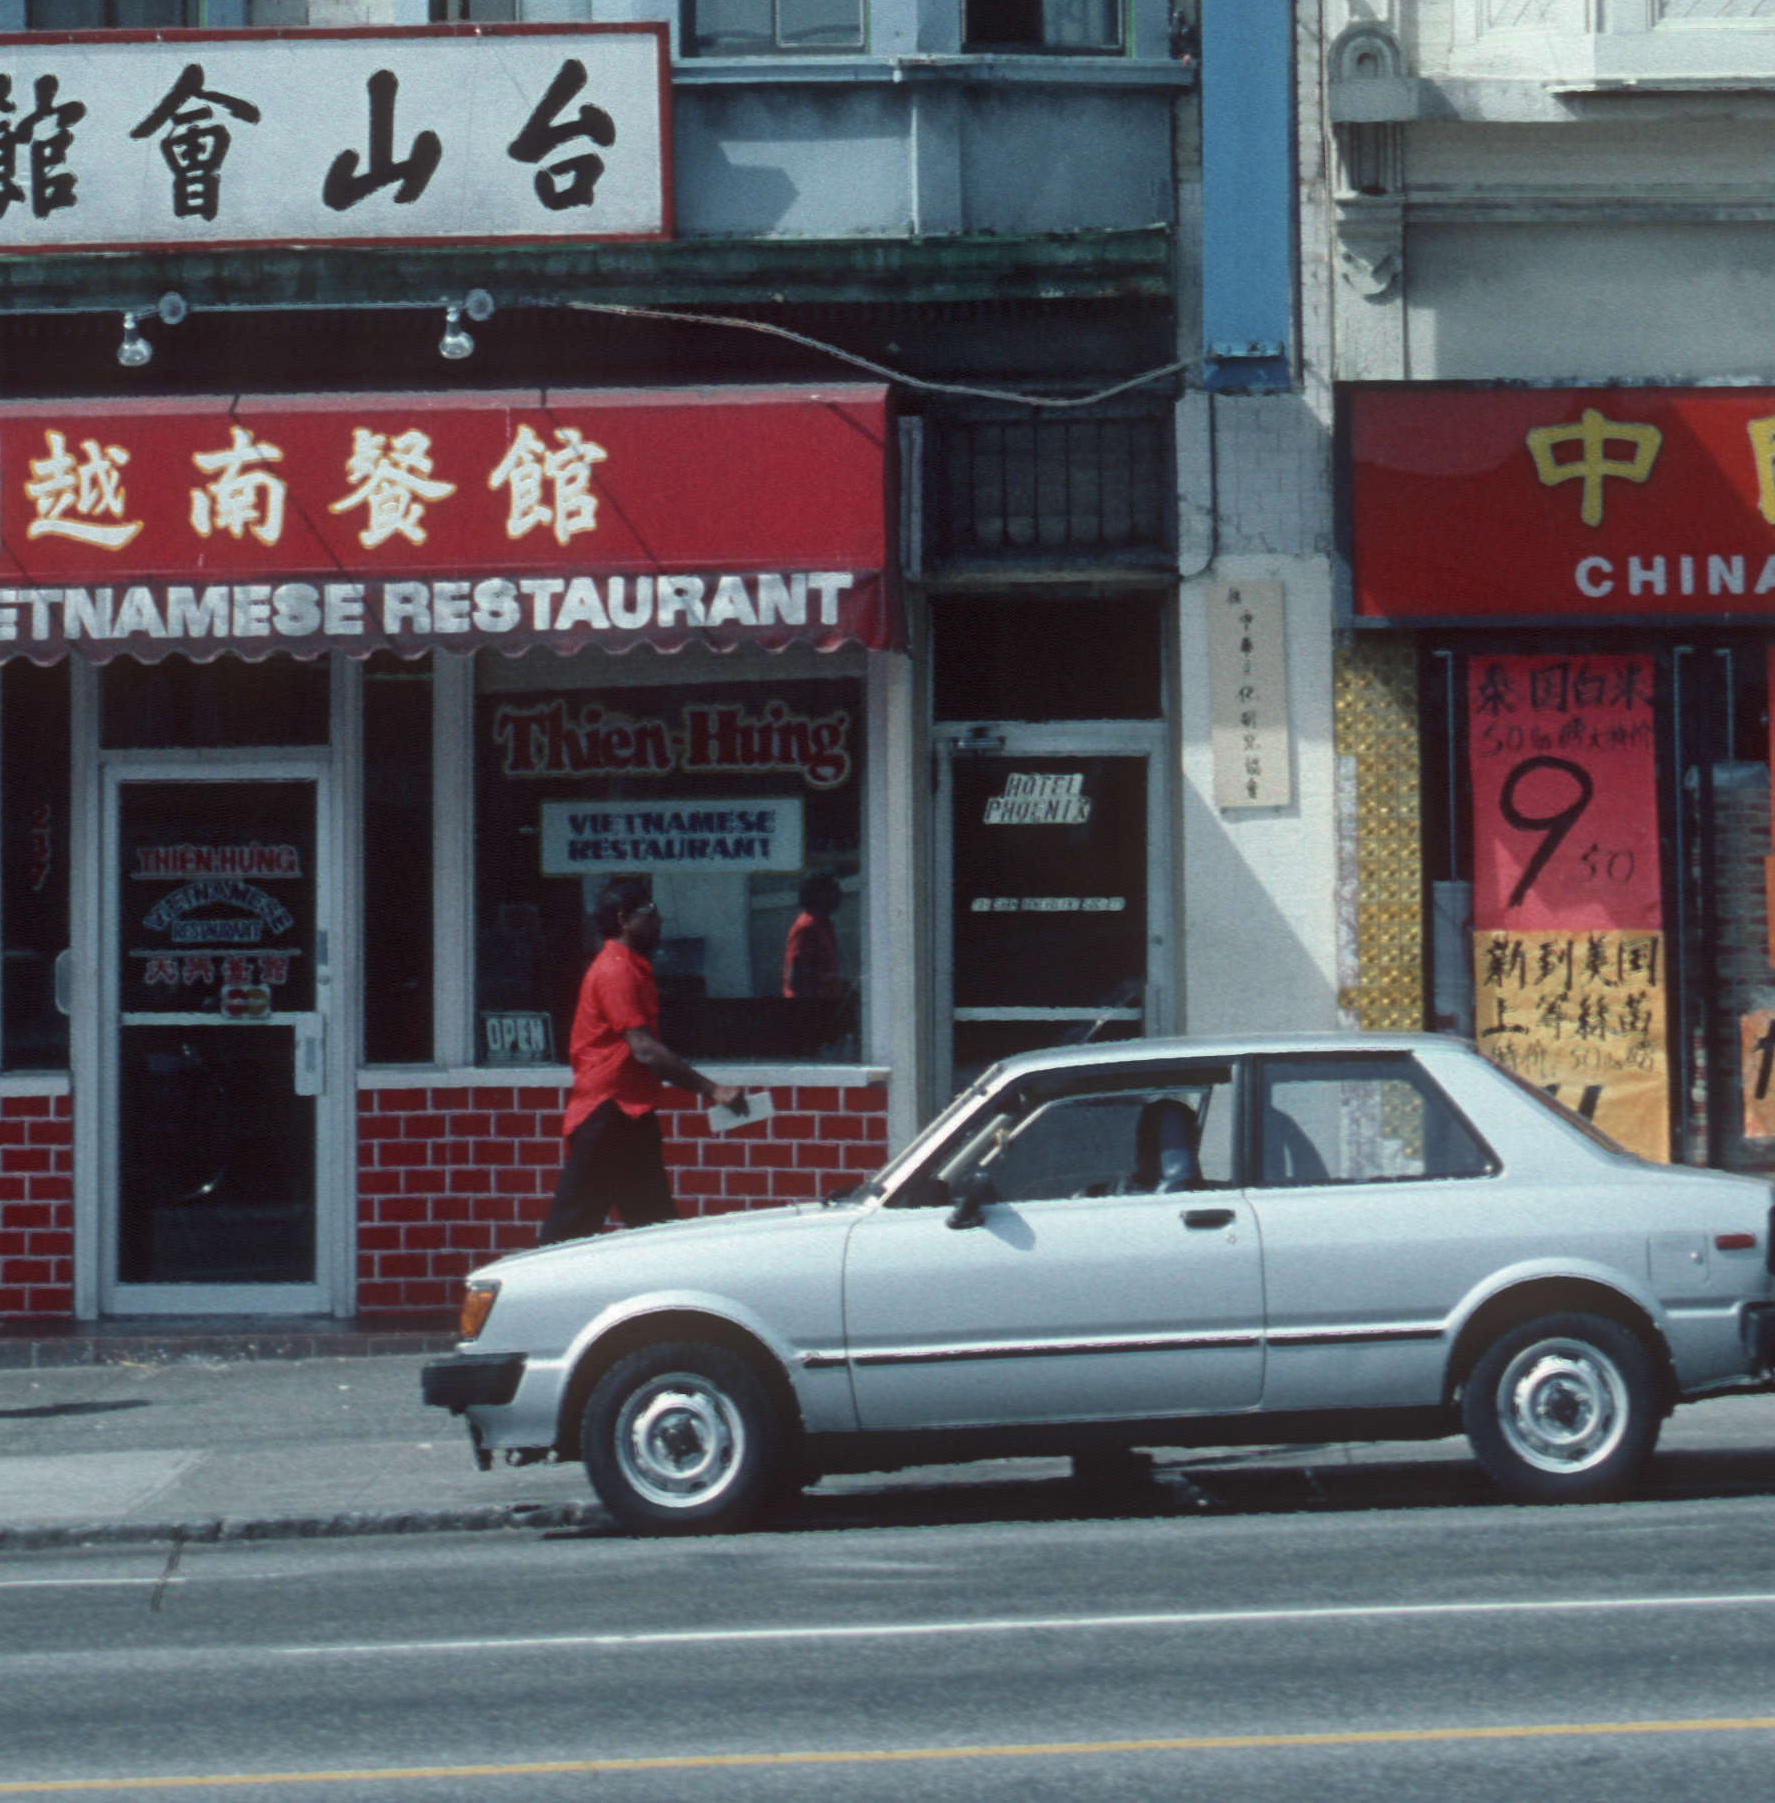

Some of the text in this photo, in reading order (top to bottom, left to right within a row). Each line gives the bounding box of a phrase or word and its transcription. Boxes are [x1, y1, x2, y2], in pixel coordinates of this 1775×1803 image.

[382, 571, 854, 635] RESTAURANT
[1005, 773, 1082, 797] HOTEL
[567, 808, 777, 836] VIETNAMESE
[984, 797, 1091, 823] PHOENIX
[1498, 755, 1594, 909] 9
[567, 836, 772, 862] RESTAURANT
[485, 1017, 545, 1052] OPEN
